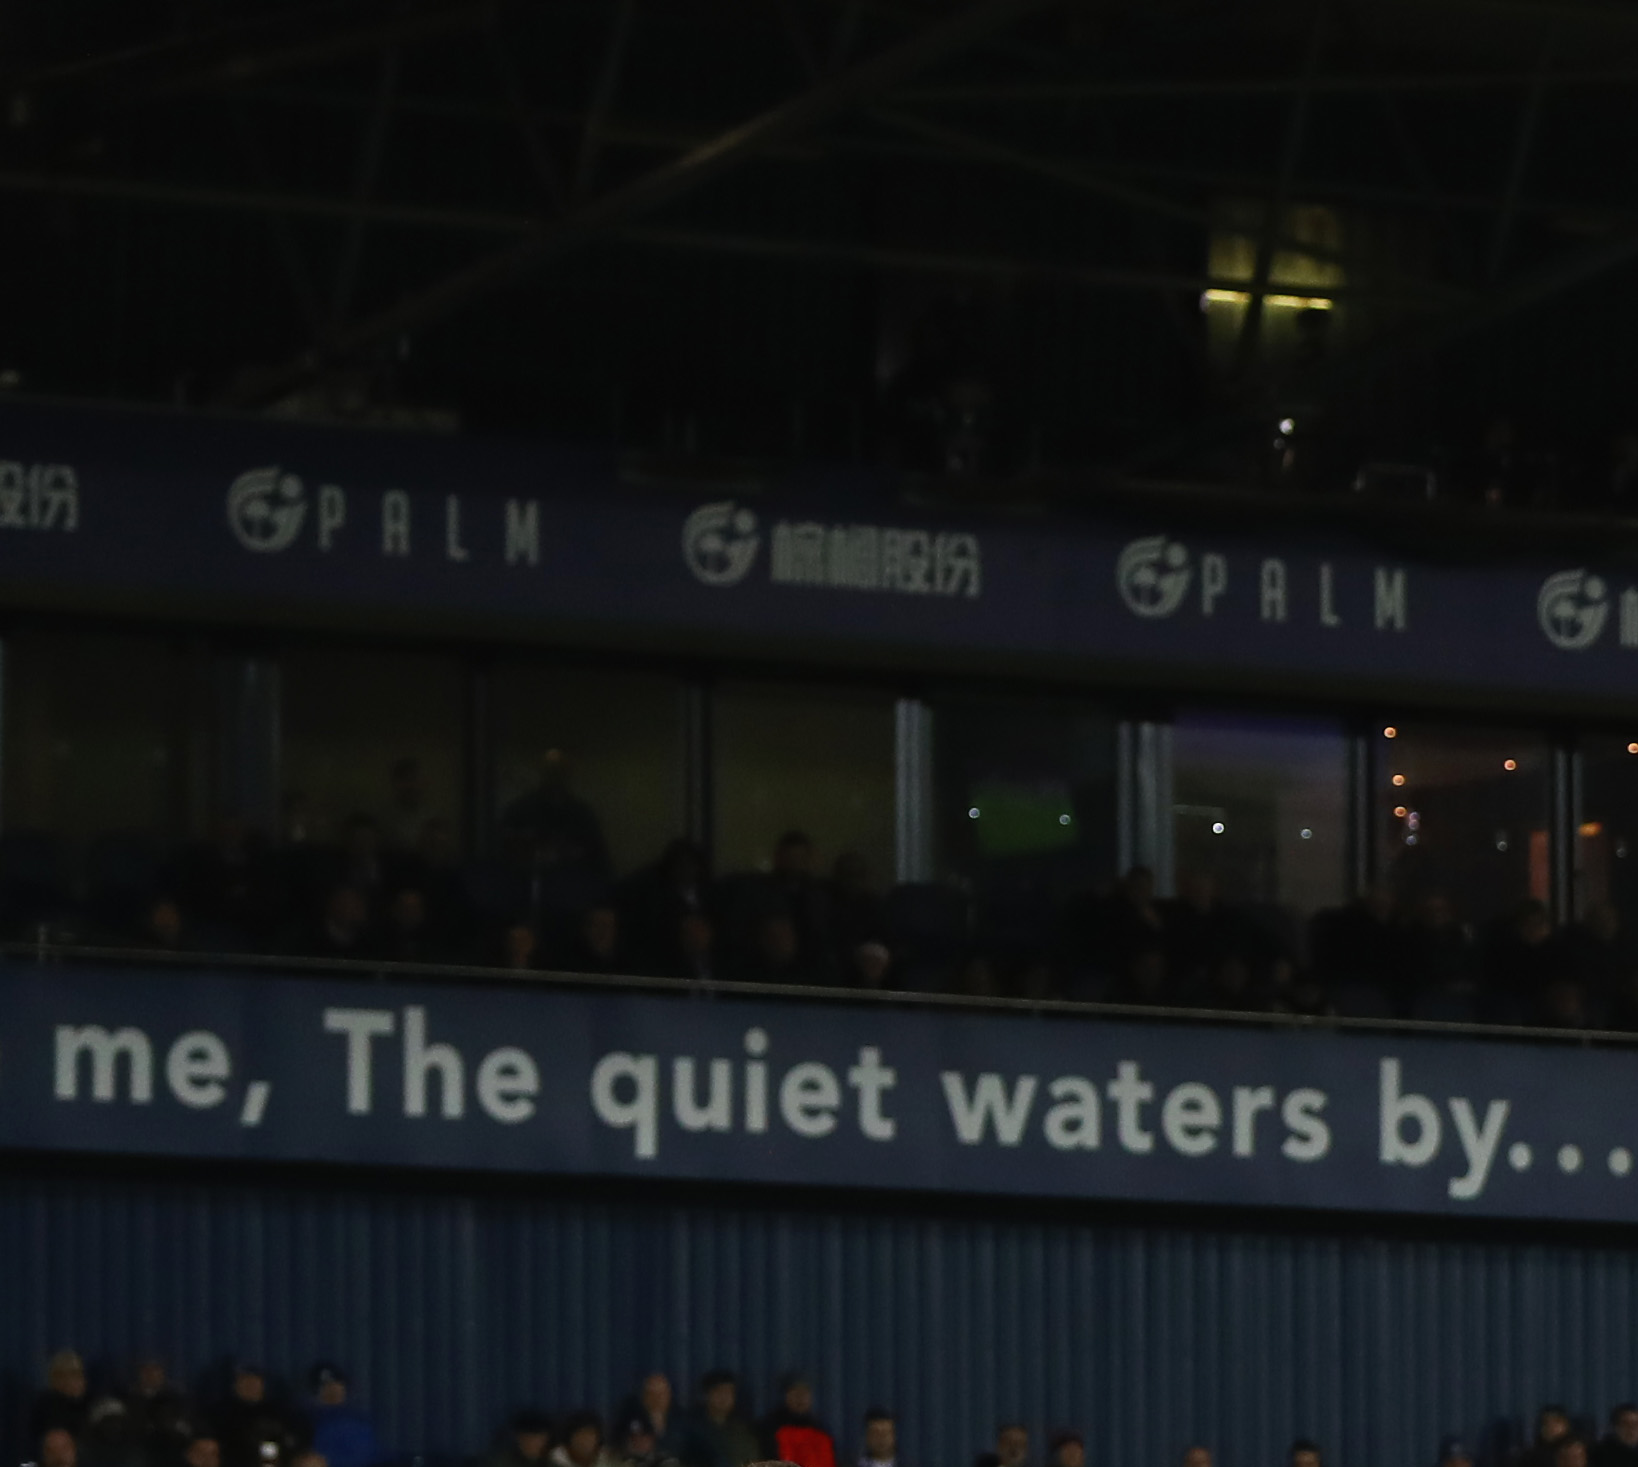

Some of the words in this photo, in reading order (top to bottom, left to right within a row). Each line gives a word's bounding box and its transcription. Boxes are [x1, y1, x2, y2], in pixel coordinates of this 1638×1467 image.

[319, 486, 539, 565] PALM
[1202, 554, 1405, 630] PALM
[55, 1027, 268, 1125] me,
[325, 1008, 539, 1122] The
[592, 1031, 894, 1159] quiet
[943, 1063, 1330, 1161] waters
